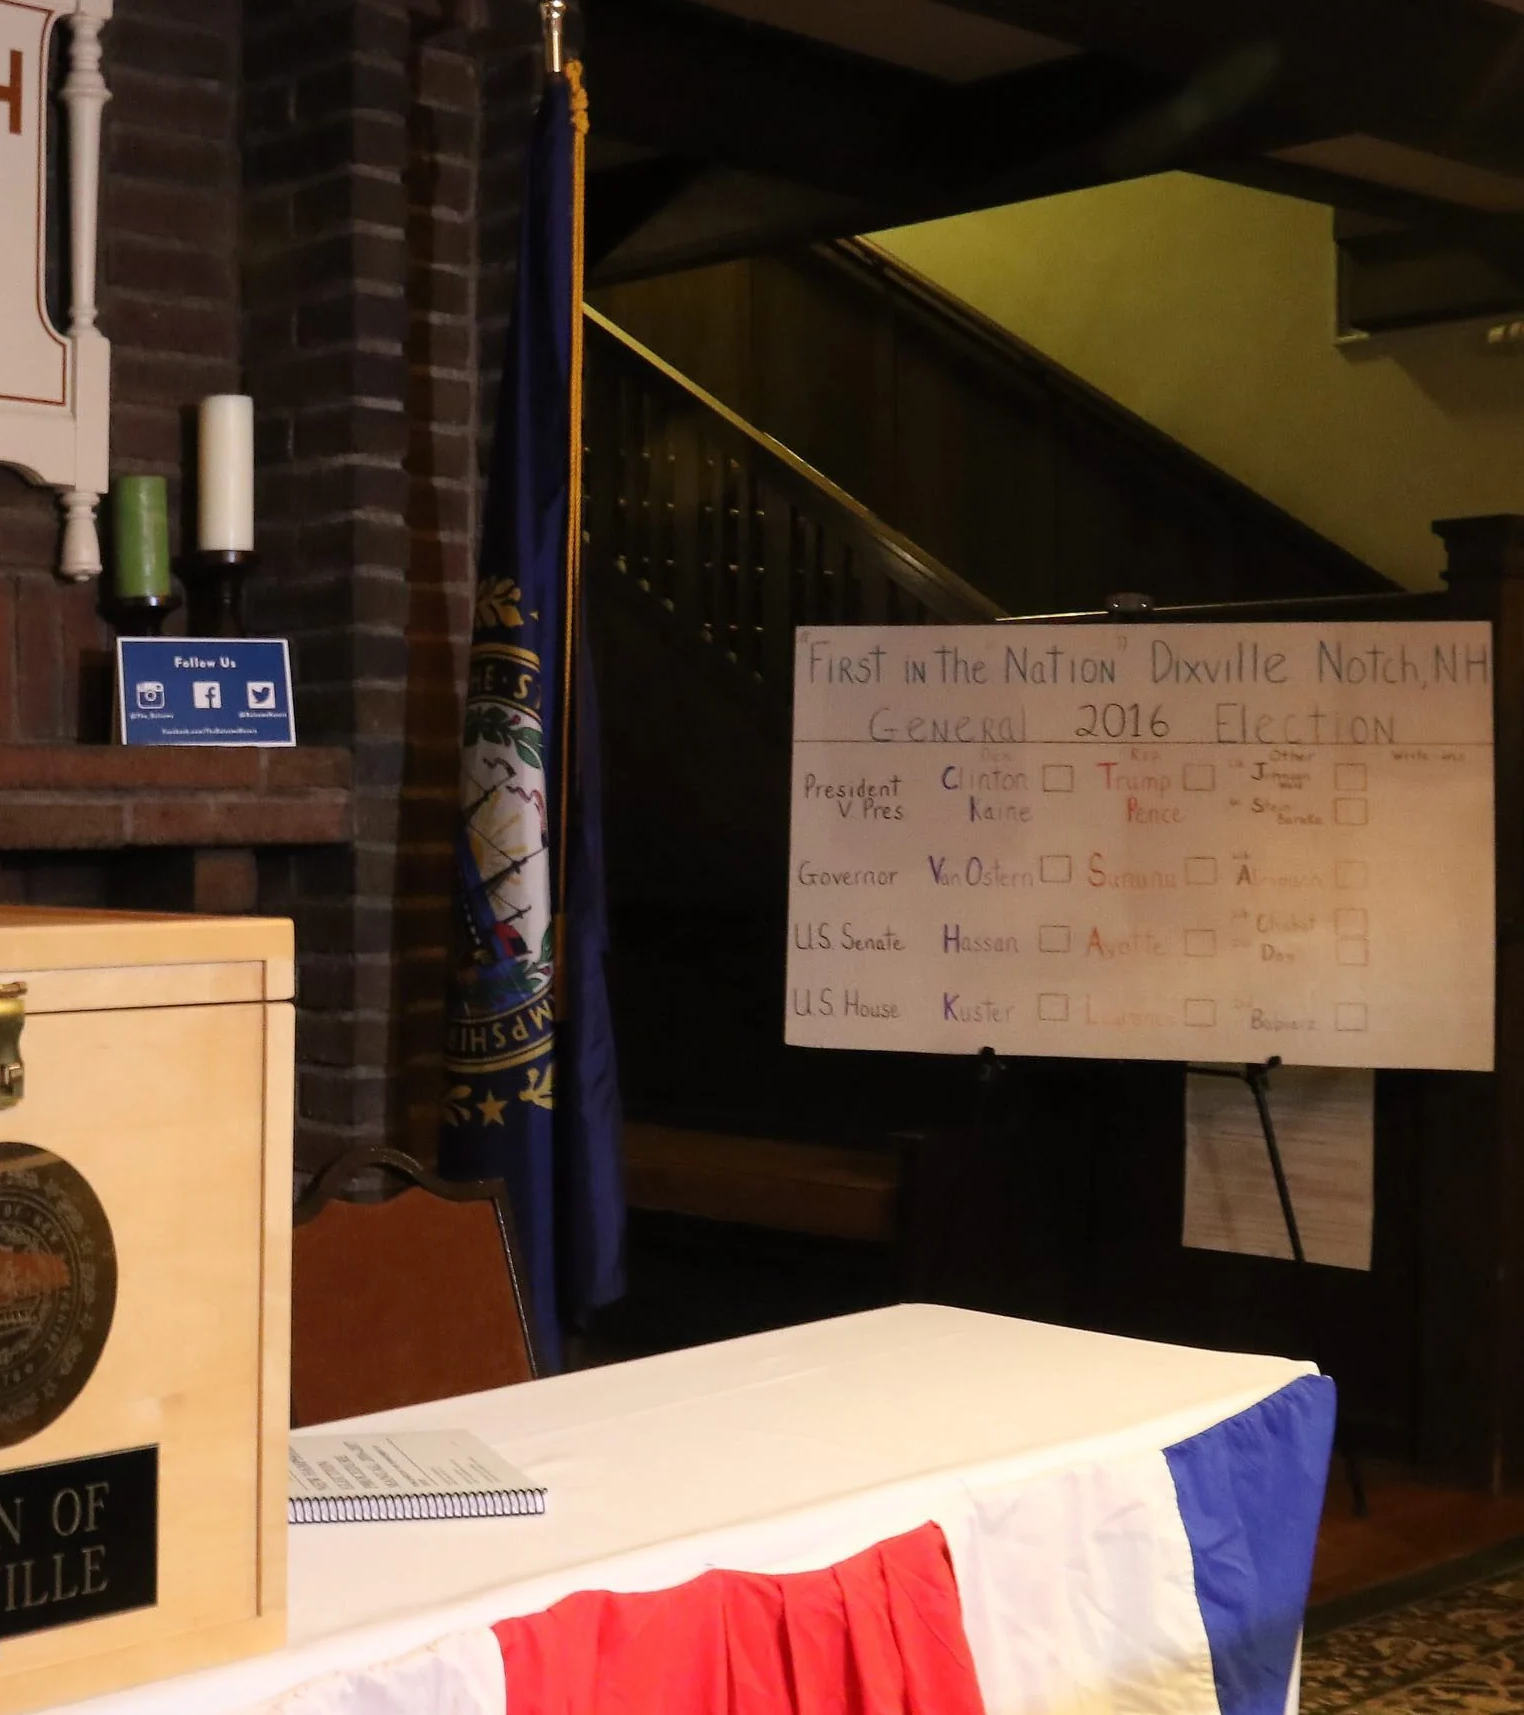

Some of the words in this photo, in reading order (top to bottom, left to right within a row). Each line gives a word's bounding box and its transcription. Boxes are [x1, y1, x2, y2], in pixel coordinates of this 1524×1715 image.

[174, 656, 216, 669] Follow
[220, 656, 236, 669] Us
[1076, 703, 1170, 739] 2016
[804, 773, 903, 799] President
[941, 766, 1029, 792] Clinton
[1096, 762, 1171, 798] Trump
[863, 797, 904, 820] Pres
[970, 796, 1032, 824] Kaine
[1127, 797, 1186, 824] Pence
[799, 861, 899, 887] Governor
[842, 922, 906, 952] Senate
[944, 924, 1020, 954] Hassan
[844, 988, 901, 1019] House
[943, 991, 1016, 1023] Kuster
[51, 1481, 110, 1537] OF
